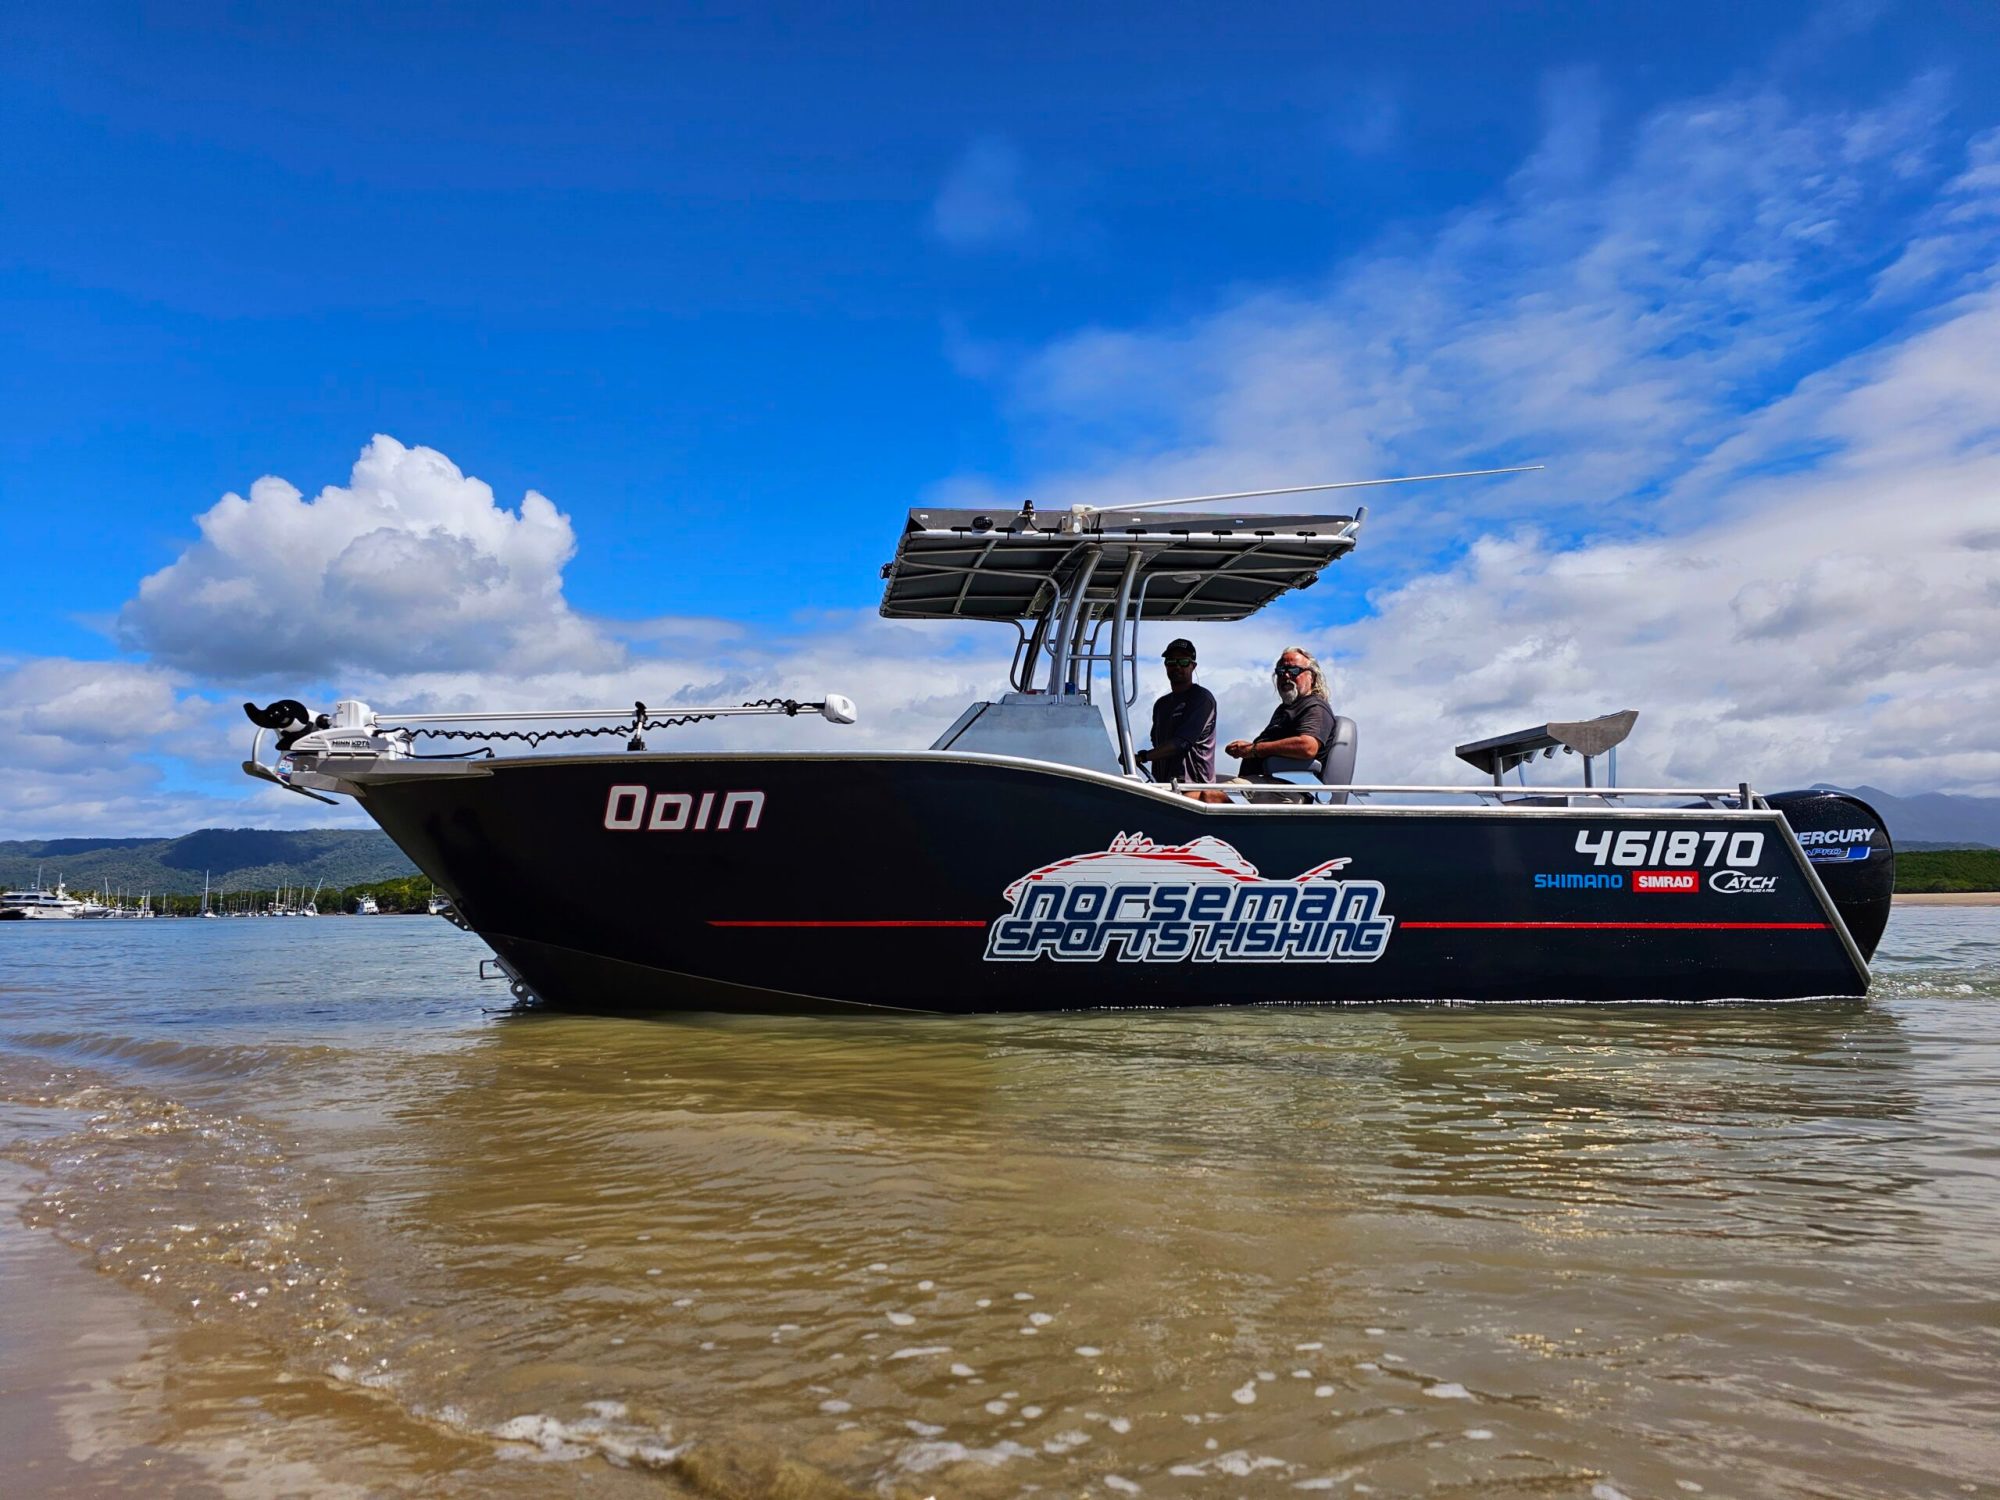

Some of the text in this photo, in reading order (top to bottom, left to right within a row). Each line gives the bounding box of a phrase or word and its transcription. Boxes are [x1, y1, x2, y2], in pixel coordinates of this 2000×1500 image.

[1575, 830, 1765, 867] 461870
[1534, 873, 1623, 889] SHIMANO
[1638, 875, 1694, 888] SIMRAD
[1708, 869, 1777, 894] CATCH
